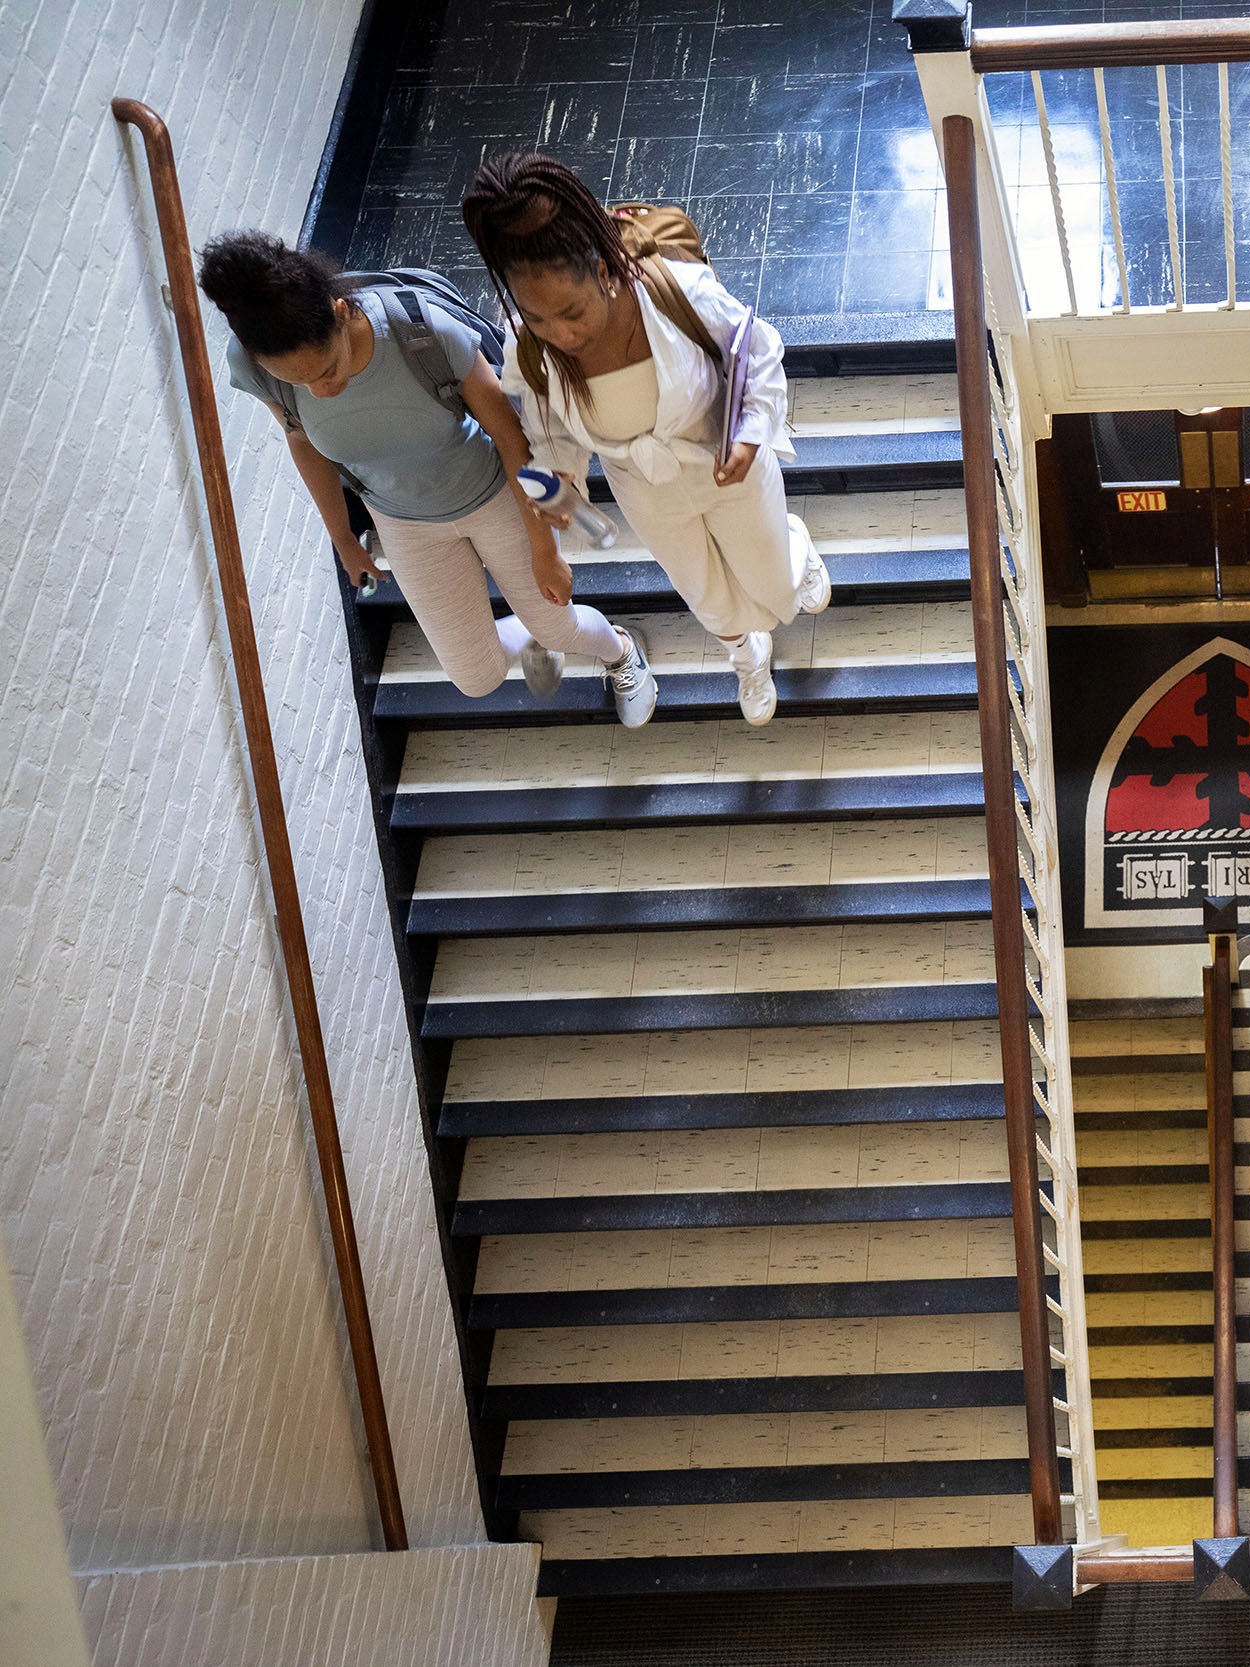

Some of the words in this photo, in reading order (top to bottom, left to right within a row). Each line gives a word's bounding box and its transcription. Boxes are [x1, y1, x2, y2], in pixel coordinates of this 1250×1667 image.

[1120, 493, 1161, 511] EXIT
[1135, 870, 1177, 889] TAS
[1224, 866, 1250, 886] RI
